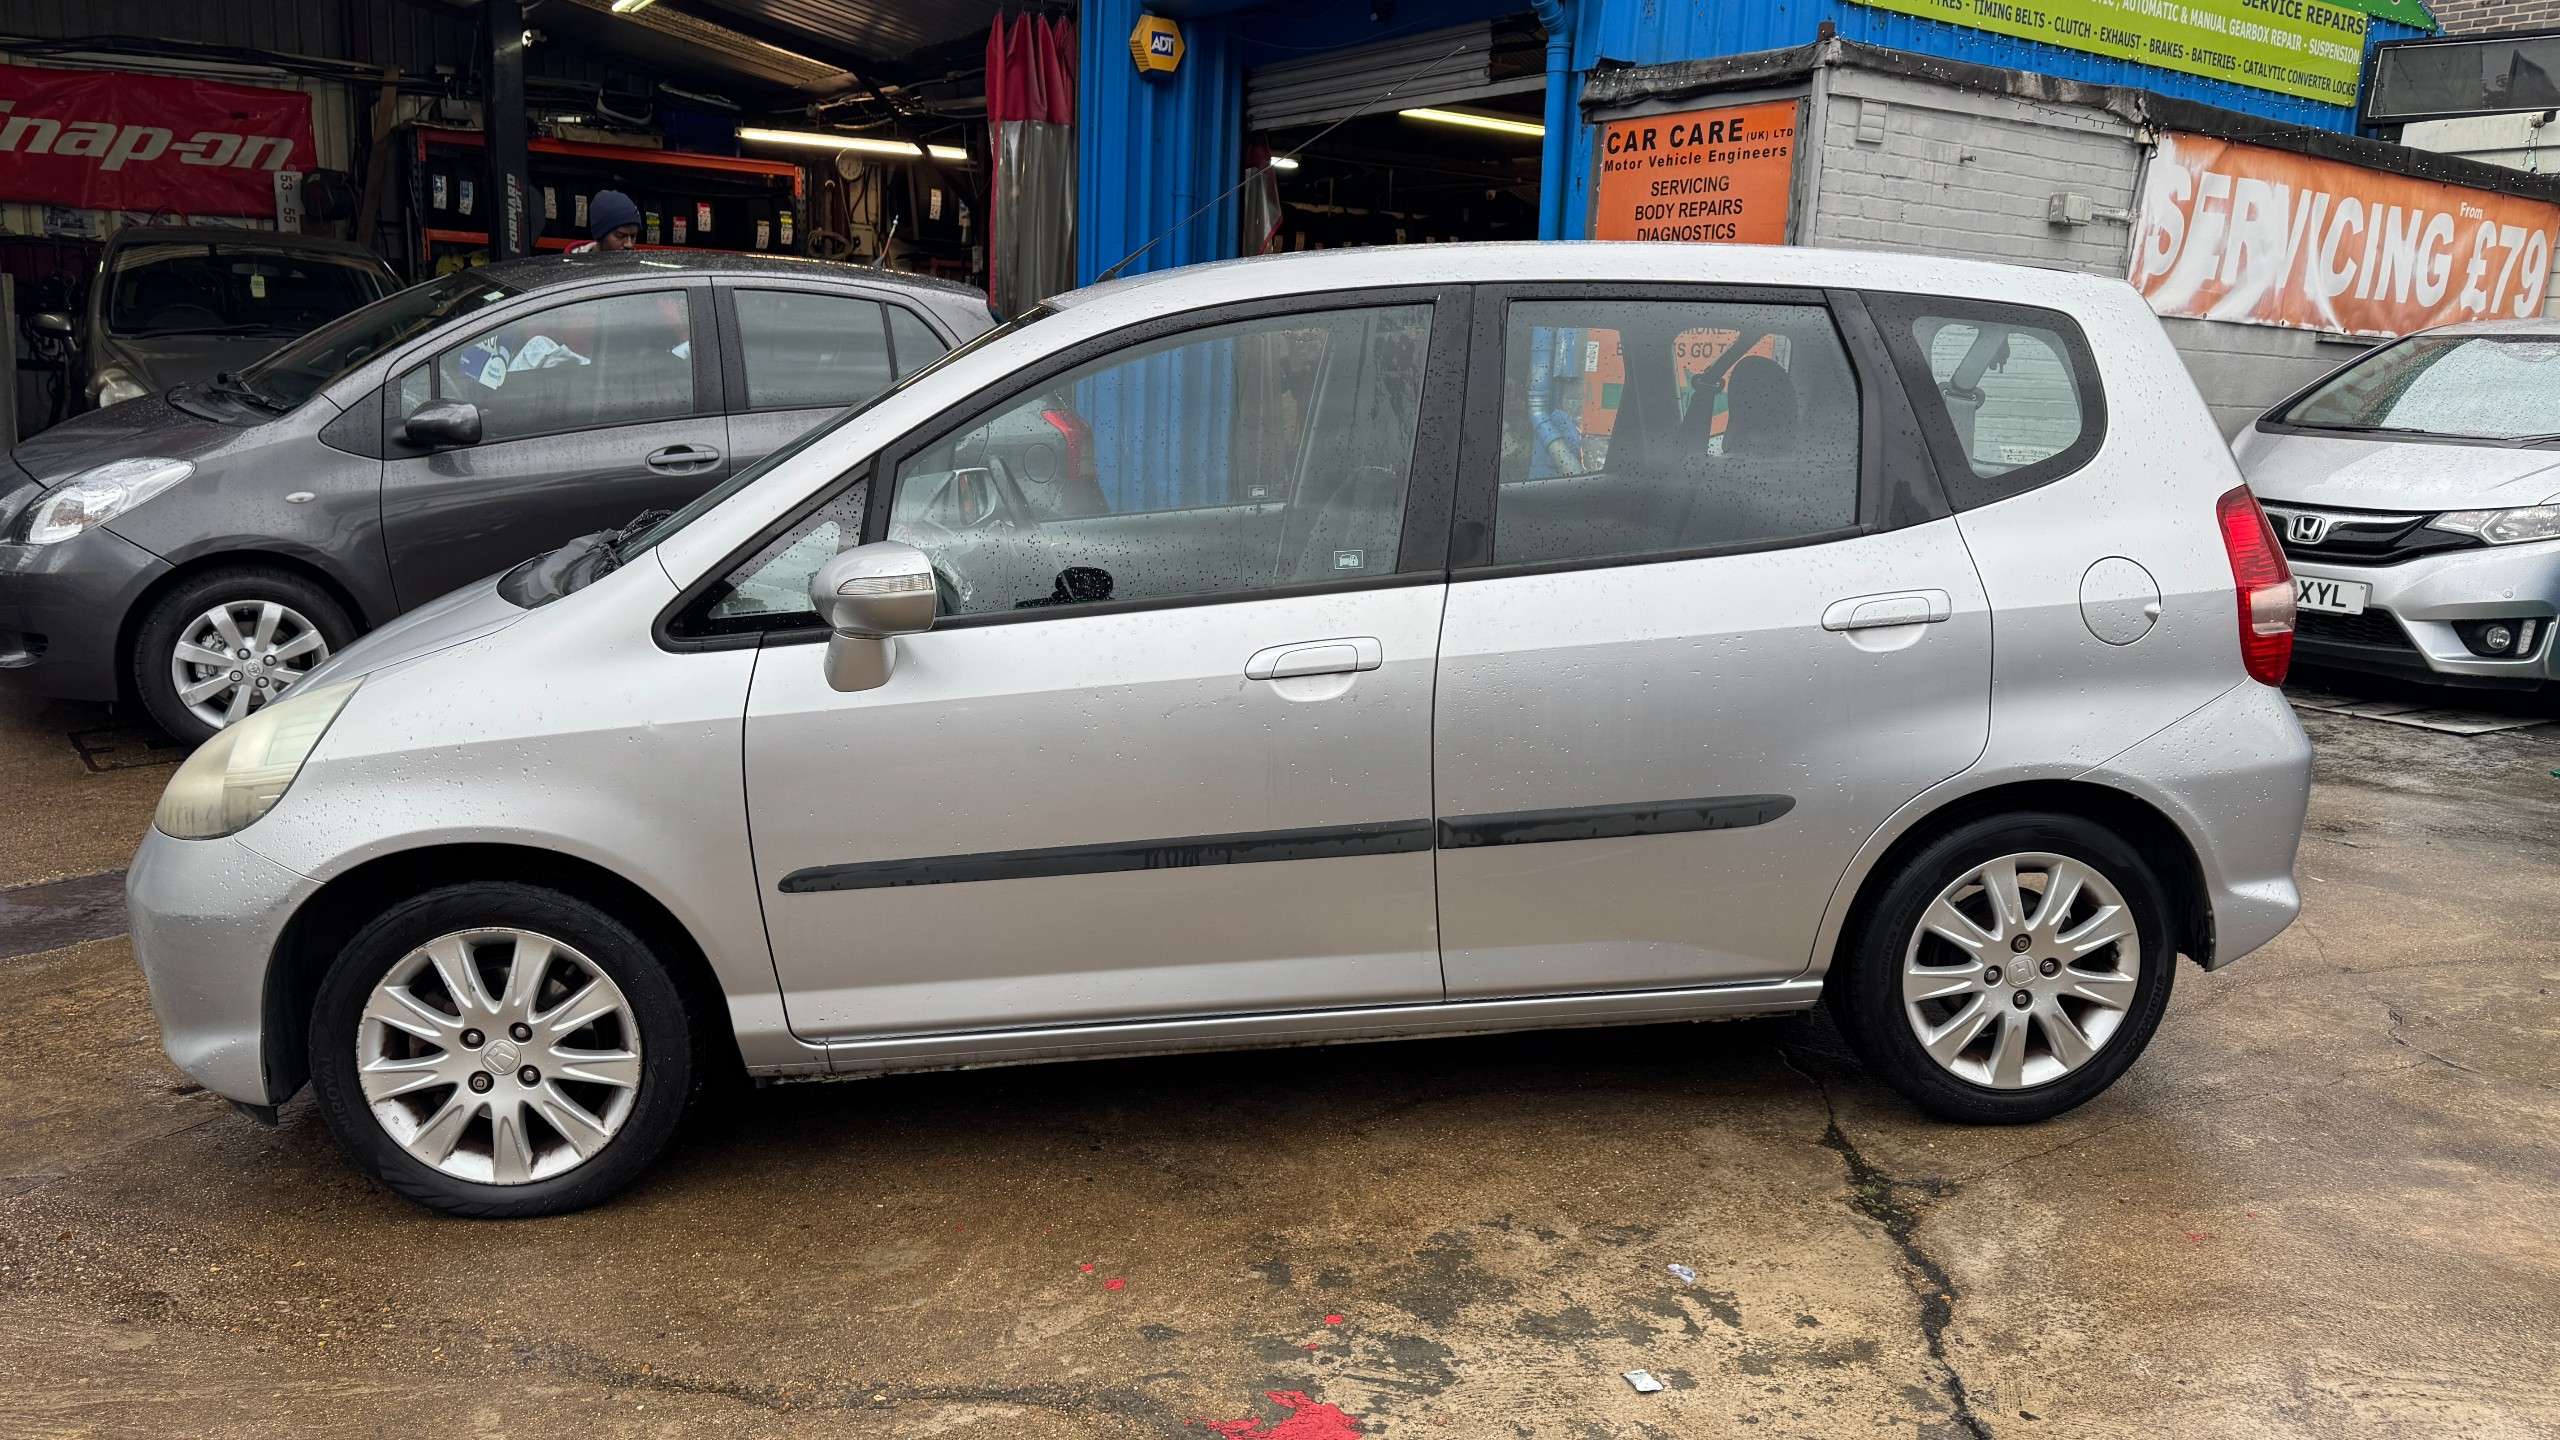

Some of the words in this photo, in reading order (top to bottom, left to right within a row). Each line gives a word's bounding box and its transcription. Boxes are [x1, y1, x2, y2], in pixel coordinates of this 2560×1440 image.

[2306, 5, 2364, 35] REPAIRS
[1151, 35, 1174, 53] ADT
[2122, 0, 2179, 21] AUTOMATIC
[2180, 11, 2188, 25] &
[2190, 12, 2227, 34] MANUAL
[2229, 19, 2269, 44] GEARBOX
[2271, 28, 2302, 51] REPAIR
[2308, 38, 2360, 65] SUSPENSION
[1973, 0, 2012, 20] TIMING
[2014, 8, 2045, 28] BELTS
[2055, 17, 2091, 39] CLUTCH
[2100, 27, 2142, 49] EXHAUST
[2149, 38, 2183, 59] BRAKES
[2191, 48, 2236, 71] BATTERIES
[2243, 59, 2285, 81] CATALYTIC
[2287, 70, 2331, 92] CONVERTER
[2332, 80, 2355, 97] LOCKS
[1606, 128, 1657, 154] CAR
[1669, 118, 1744, 148] CARE
[1746, 130, 1769, 142] (UK)
[1773, 128, 1793, 138] LTD
[1604, 157, 1643, 172] Motor
[1648, 149, 1701, 168] Vehicle
[1708, 146, 1787, 165] Engineers
[280, 174, 293, 190] 53
[1651, 175, 1729, 197] SERVICING
[283, 207, 296, 223] 55
[506, 173, 520, 254] FORWARD
[1635, 202, 1675, 221] BODY
[1678, 198, 1743, 217] REPAIRS
[2460, 201, 2483, 219] From
[1636, 223, 1736, 242] DIAGNOSTICS
[2145, 163, 2454, 308] SERVICING
[2460, 220, 2548, 318] £79
[1691, 342, 1713, 358] GO
[2297, 580, 2347, 608] XYL
